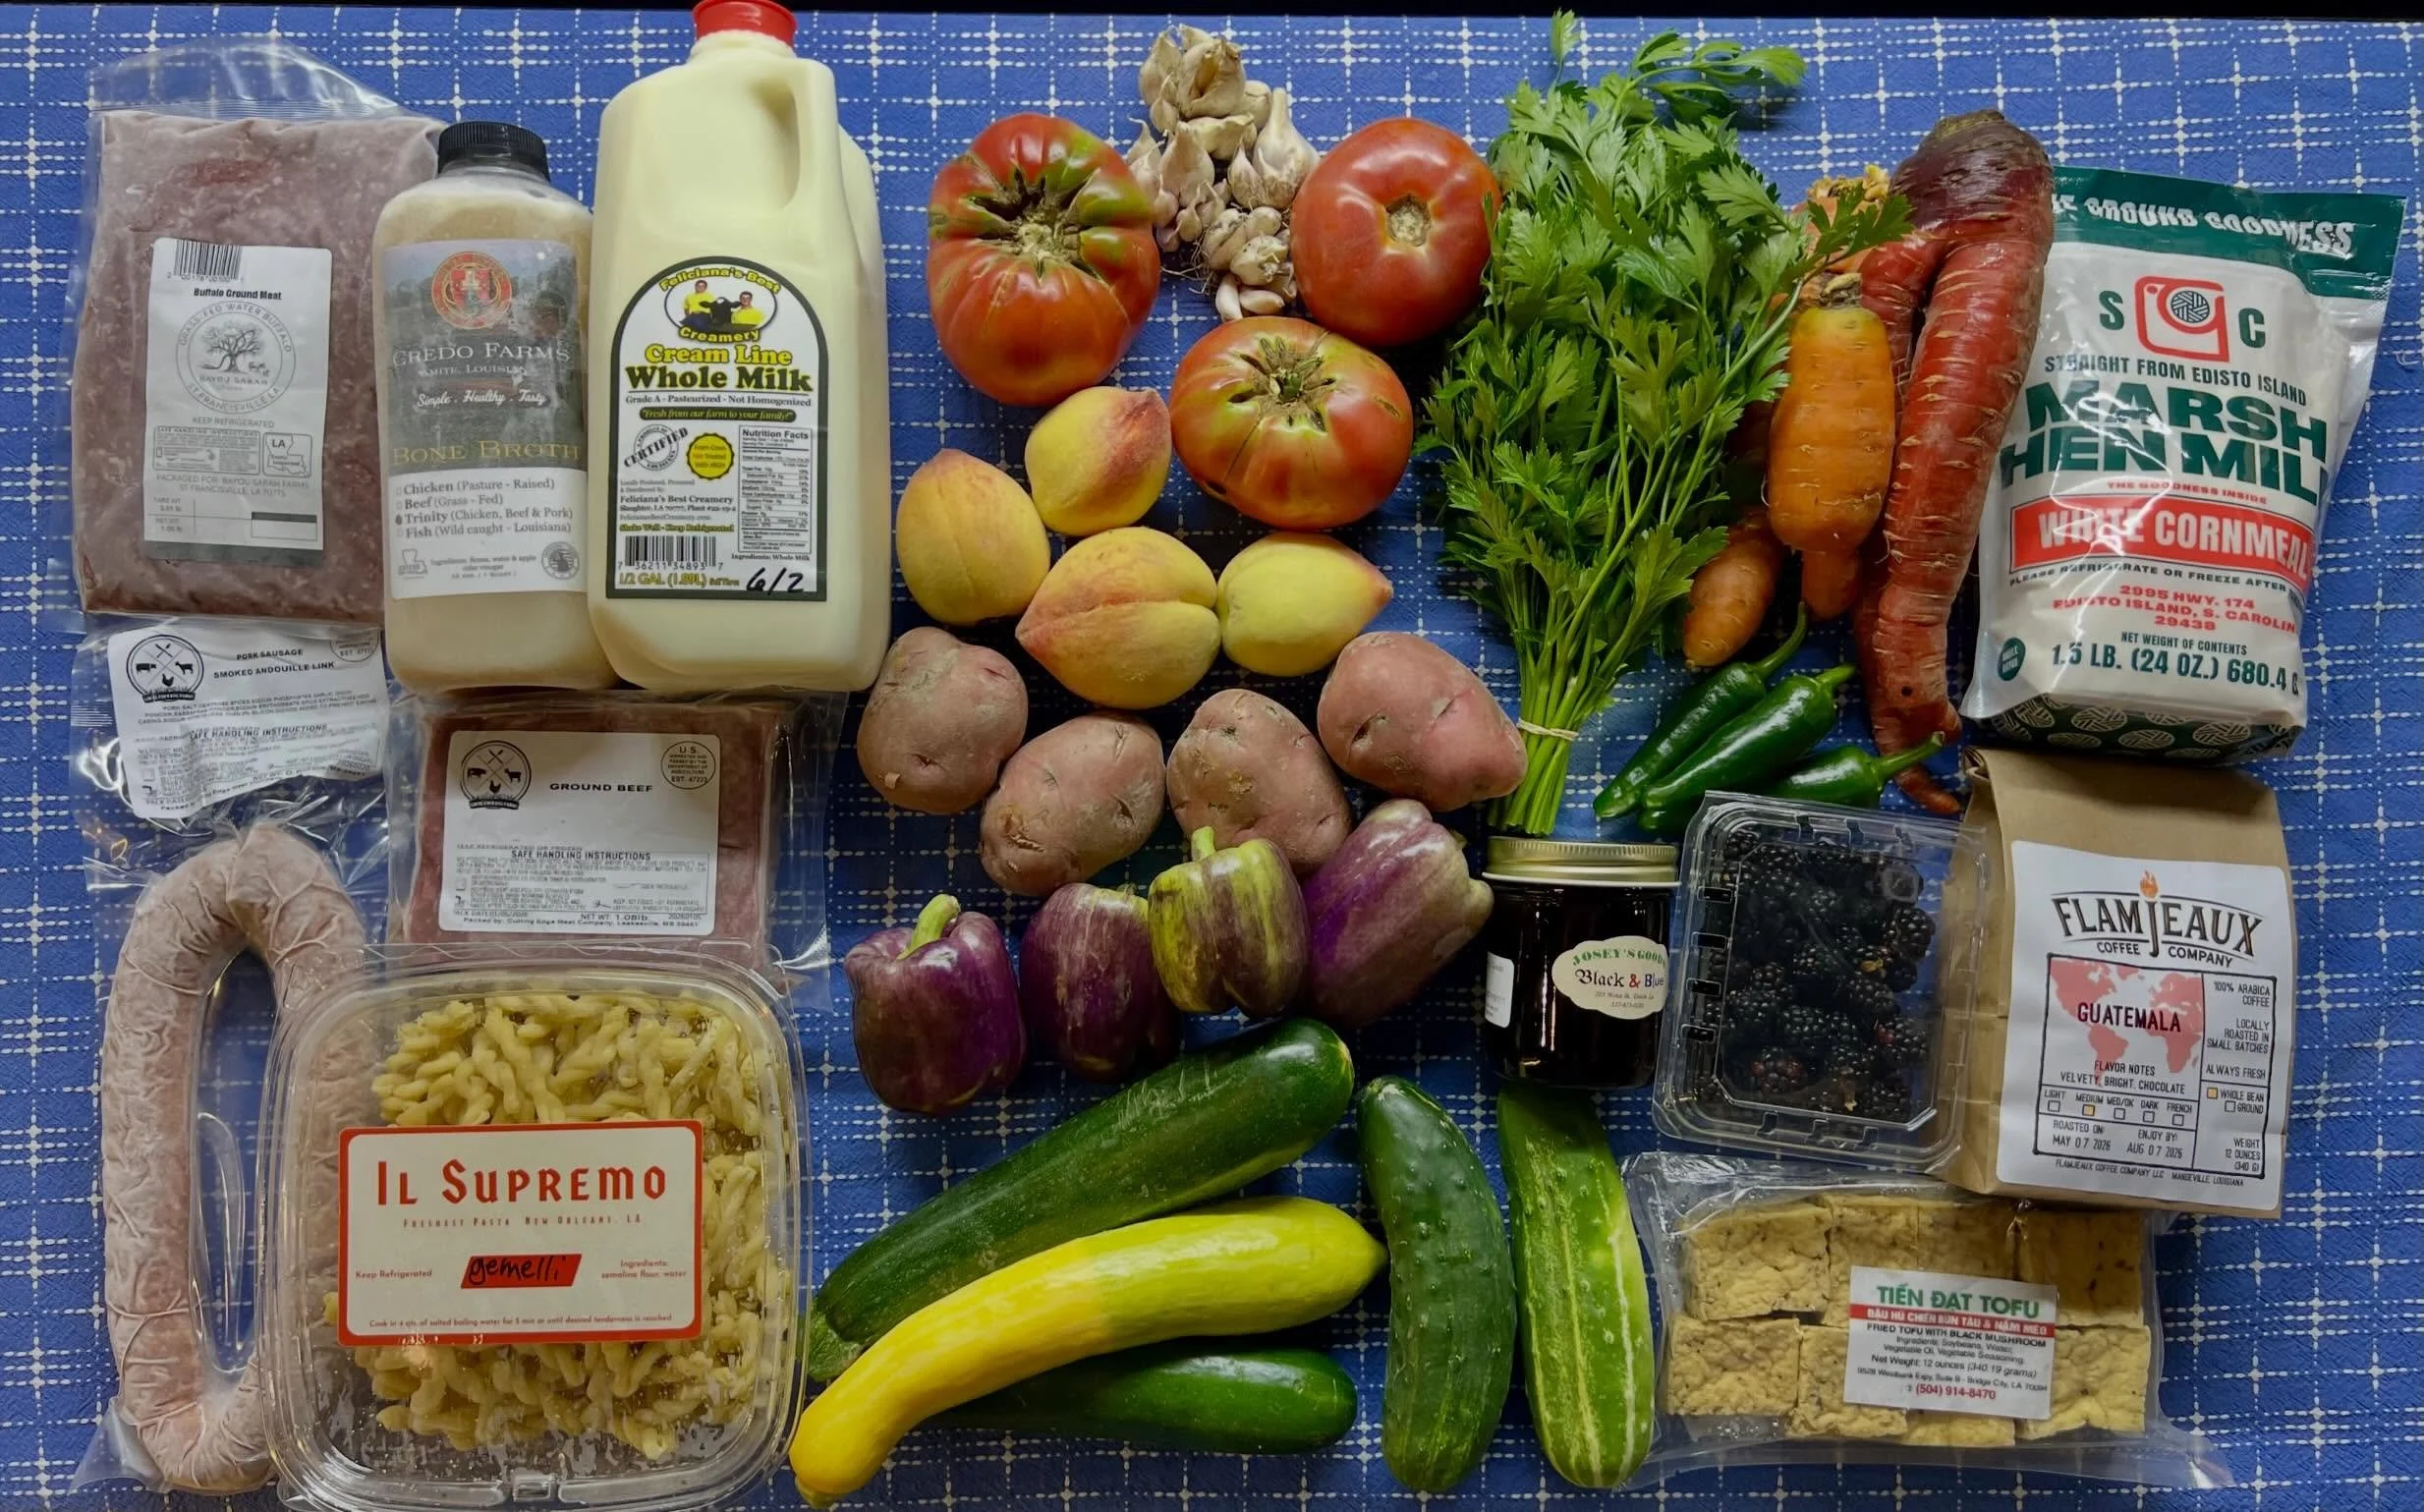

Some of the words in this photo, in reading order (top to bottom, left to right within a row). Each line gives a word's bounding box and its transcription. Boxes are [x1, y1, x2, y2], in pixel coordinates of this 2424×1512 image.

[2084, 196, 2199, 228] GROUND
[2204, 212, 2357, 260] GOODNESS
[659, 266, 744, 292] Feliciana's
[746, 271, 781, 294] Best
[194, 288, 224, 297] Buffalo
[226, 289, 257, 300] Ground
[259, 290, 282, 300] Meat
[2099, 289, 2125, 331] S
[2238, 307, 2266, 349] C
[227, 304, 260, 315] WATER
[262, 313, 292, 353] BUFFALO
[678, 326, 761, 342] Creamery
[393, 345, 474, 366] CREDO
[484, 342, 570, 362] FARMS
[645, 343, 730, 364] Cream
[735, 344, 792, 365] Line
[625, 365, 728, 389] Whole
[736, 365, 814, 392] Milk
[2044, 355, 2129, 374] STRAIGHT
[2136, 357, 2186, 380] FROM
[2191, 365, 2251, 389] EDISTO
[2257, 374, 2307, 407] ISLAND
[417, 392, 451, 408] Simple
[463, 389, 506, 406] Healthy
[518, 389, 546, 406] Tasty
[626, 395, 652, 404] Grade
[668, 395, 721, 404] Pasteurized
[728, 395, 745, 405] Not
[747, 396, 812, 407] Homogenized
[214, 418, 275, 428] REFRIGERATED
[2024, 379, 2328, 464] MARSH
[742, 428, 782, 438] Nutrition
[784, 430, 810, 440] Facts
[272, 439, 286, 448] LA
[624, 426, 689, 469] CERTIFIED
[393, 445, 466, 465] BONE
[479, 440, 580, 461] BROTH
[2000, 426, 2167, 488] HEN
[2179, 431, 2328, 506] MIL
[404, 481, 454, 495] Chicken
[457, 480, 503, 492] (Pasture
[513, 478, 555, 489] Raised)
[2107, 481, 2134, 490] THE
[2138, 481, 2219, 496] GOODNESS
[2223, 489, 2268, 505] INSIDE
[405, 498, 432, 510] Beef
[434, 497, 468, 507] (Grass
[479, 495, 503, 505] Fed)
[620, 495, 666, 504] Feliciana's
[668, 495, 687, 504] Best
[689, 496, 733, 506] Creamery
[405, 512, 447, 525] Trinity
[505, 508, 530, 519] Beef
[532, 508, 540, 517] &
[544, 507, 573, 519] Pork)
[407, 526, 432, 538] Fish
[435, 526, 464, 536] (Wild
[467, 524, 503, 535] caught
[514, 522, 571, 533] Louisiana)
[2038, 507, 2144, 549] WHITE
[2154, 510, 2309, 582] CORNMEAL
[746, 567, 804, 595] 6/2
[2009, 568, 2056, 587] PLEASE
[2164, 568, 2183, 578] OR
[2188, 573, 2241, 586] FREEZE
[2245, 578, 2286, 591] AFTER
[2119, 585, 2170, 600] 2995
[2172, 591, 2220, 608] HWY.
[2224, 598, 2255, 610] 174
[2125, 598, 2198, 618] ISLAND,
[2154, 615, 2217, 631] 29438
[2121, 631, 2140, 644] NET
[2142, 634, 2180, 648] WEIGHT
[2182, 637, 2195, 649] OF
[2198, 638, 2247, 655] CONTENTS
[236, 652, 260, 661] PORK
[260, 648, 304, 659] SAUSAGE
[213, 669, 254, 679] SMOKED
[2052, 643, 2082, 666] 1.5
[2090, 643, 2122, 670] LB.
[2131, 647, 2169, 675] (24
[2177, 654, 2219, 680] OZ.)
[2227, 657, 2286, 691] 680.4
[212, 728, 260, 738] HANDLING
[262, 724, 327, 736] INSTRUCTIONS
[549, 783, 612, 792] GROUND
[617, 784, 653, 793] BEEF
[511, 850, 534, 859] SAFE
[536, 851, 582, 860] HANDLING
[585, 851, 651, 861] INSTRUCTIONS
[2052, 896, 2264, 958] FLAMJEAUX
[2097, 941, 2140, 955] COFFEE
[2168, 946, 2233, 969] COMPANY
[1575, 969, 1625, 988] Black
[1628, 974, 1641, 988] &
[1644, 973, 1665, 989] Blue
[2214, 981, 2234, 992] 100%
[2238, 983, 2271, 996] ARABICA
[2242, 995, 2271, 1007] COFFEE
[2077, 1002, 2182, 1033] GUATEMALA
[2235, 1019, 2270, 1031] LOCALLY
[2224, 1029, 2259, 1040] ROASTED
[2261, 1032, 2270, 1041] IN
[2207, 1038, 2232, 1049] SMALL
[2234, 1040, 2268, 1054] BATCHES
[2094, 1060, 2126, 1074] FLAVOR
[2128, 1064, 2156, 1076] NOTES
[2206, 1064, 2241, 1077] ALWAYS
[2243, 1067, 2267, 1079] FRESH
[2138, 1079, 2186, 1095] CHOCOLATE
[2044, 1089, 2066, 1100] LIGHT
[2076, 1092, 2104, 1104] MEDIUM
[2140, 1099, 2159, 1110] DARK
[2167, 1102, 2193, 1114] FRENCH
[2220, 1090, 2245, 1100] WHOLE
[2247, 1092, 2264, 1102] BEAN
[2236, 1102, 2264, 1115] GROUND
[2053, 1119, 2090, 1134] ROASTED
[2138, 1129, 2163, 1141] ENJOY
[2052, 1135, 2071, 1148] MAY
[2126, 1142, 2145, 1154] AUG
[2233, 1138, 2260, 1149] WEIGHT
[2225, 1148, 2232, 1159] 12
[2233, 1148, 2261, 1160] OUNCES
[2055, 1159, 2094, 1172] FLAMJEAUX
[2095, 1163, 2118, 1174] COFFEE
[2120, 1165, 2151, 1178] COMPANY
[356, 1269, 377, 1279] Keep
[379, 1268, 432, 1279] Refrigerated
[468, 1255, 568, 1286] gemelli
[663, 1269, 687, 1278] water
[1877, 1283, 1924, 1307] TIẾN
[1931, 1290, 1973, 1313] ĐẠT
[1979, 1295, 2040, 1318] TOFU
[1867, 1323, 1896, 1333] FRIED
[1899, 1325, 1923, 1335] TOFU
[1926, 1327, 1948, 1337] WITH
[1949, 1329, 1982, 1340] BLACK
[1985, 1332, 2046, 1348] MUSHROOM
[1872, 1354, 1888, 1364] Net
[1889, 1356, 1919, 1367] Weight:
[1924, 1359, 1933, 1368] 12
[1935, 1360, 1965, 1371] ounces
[2003, 1365, 2037, 1379] grams)
[1916, 1383, 1943, 1396] (504)
[1945, 1385, 1997, 1400] 914-8470
